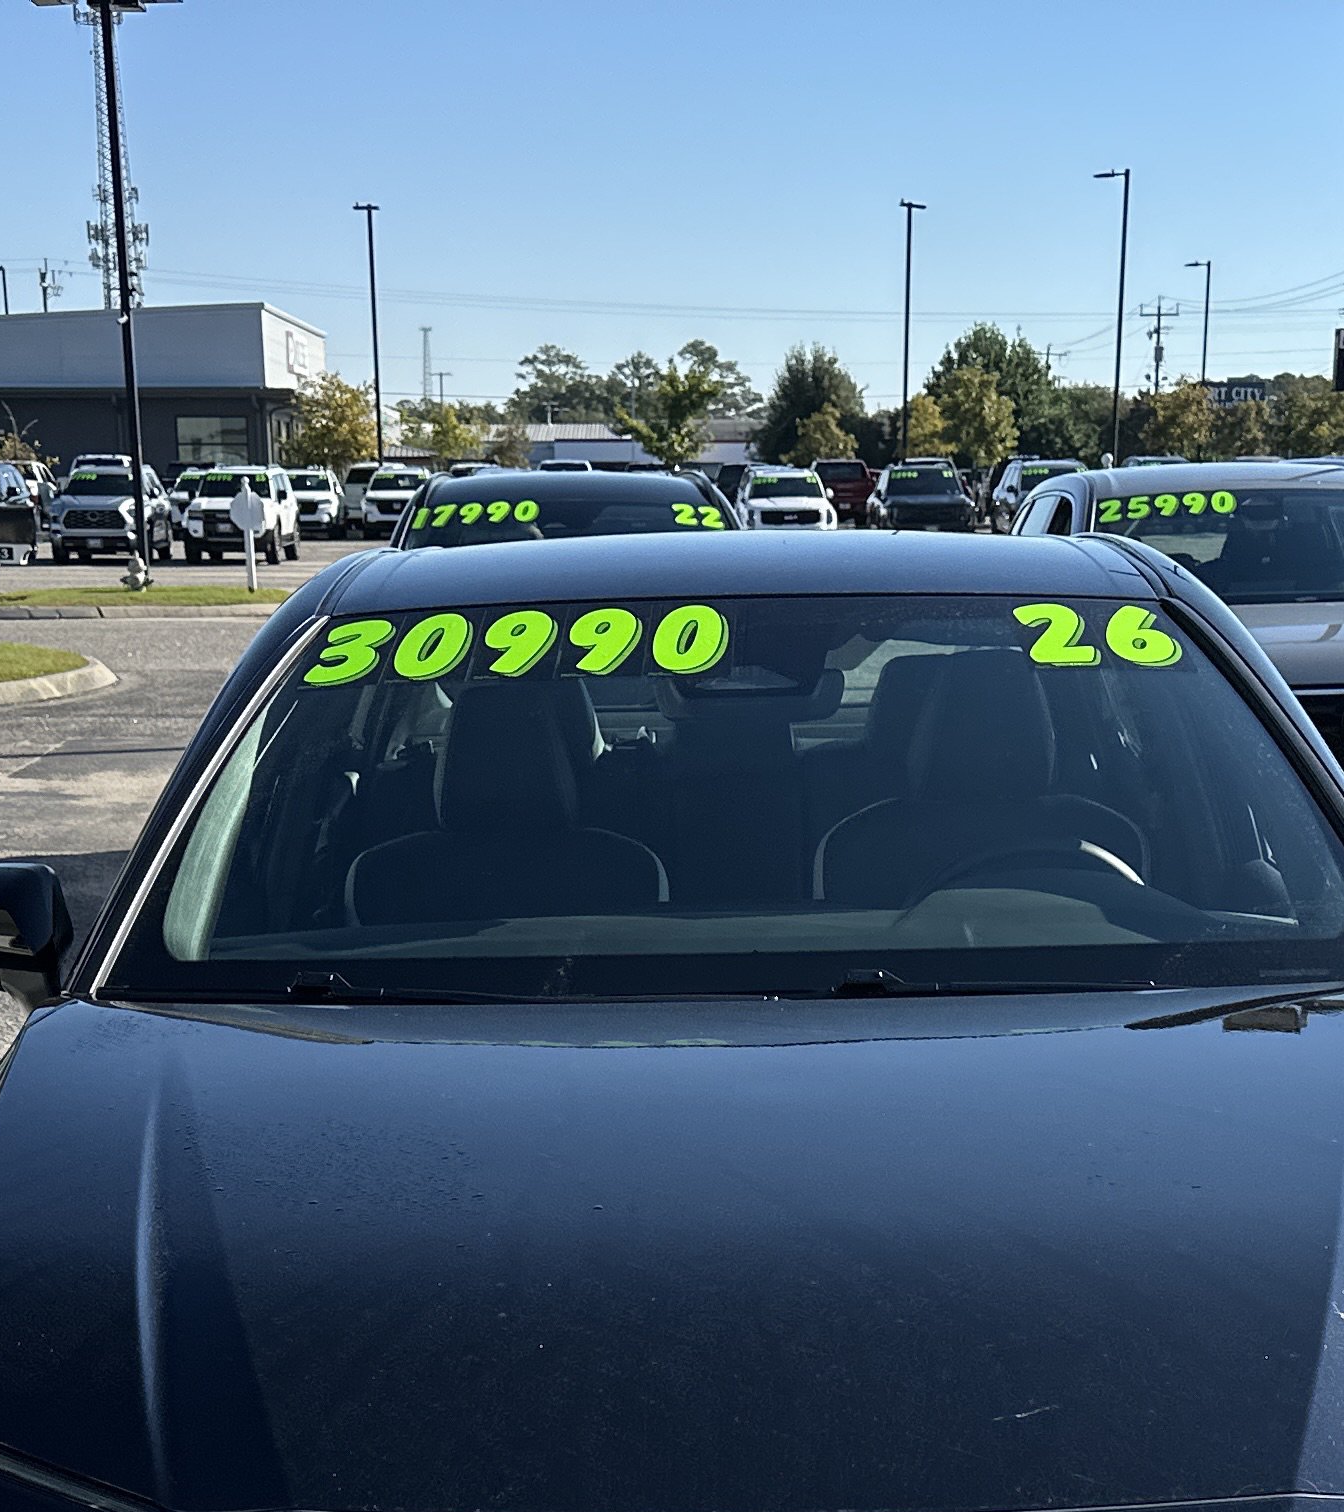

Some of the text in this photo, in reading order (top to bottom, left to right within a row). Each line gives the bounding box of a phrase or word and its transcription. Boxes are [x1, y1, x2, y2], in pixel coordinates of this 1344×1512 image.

[411, 500, 726, 530] 17990 22
[1099, 491, 1238, 523] 25990
[304, 603, 1183, 687] 30990 26
